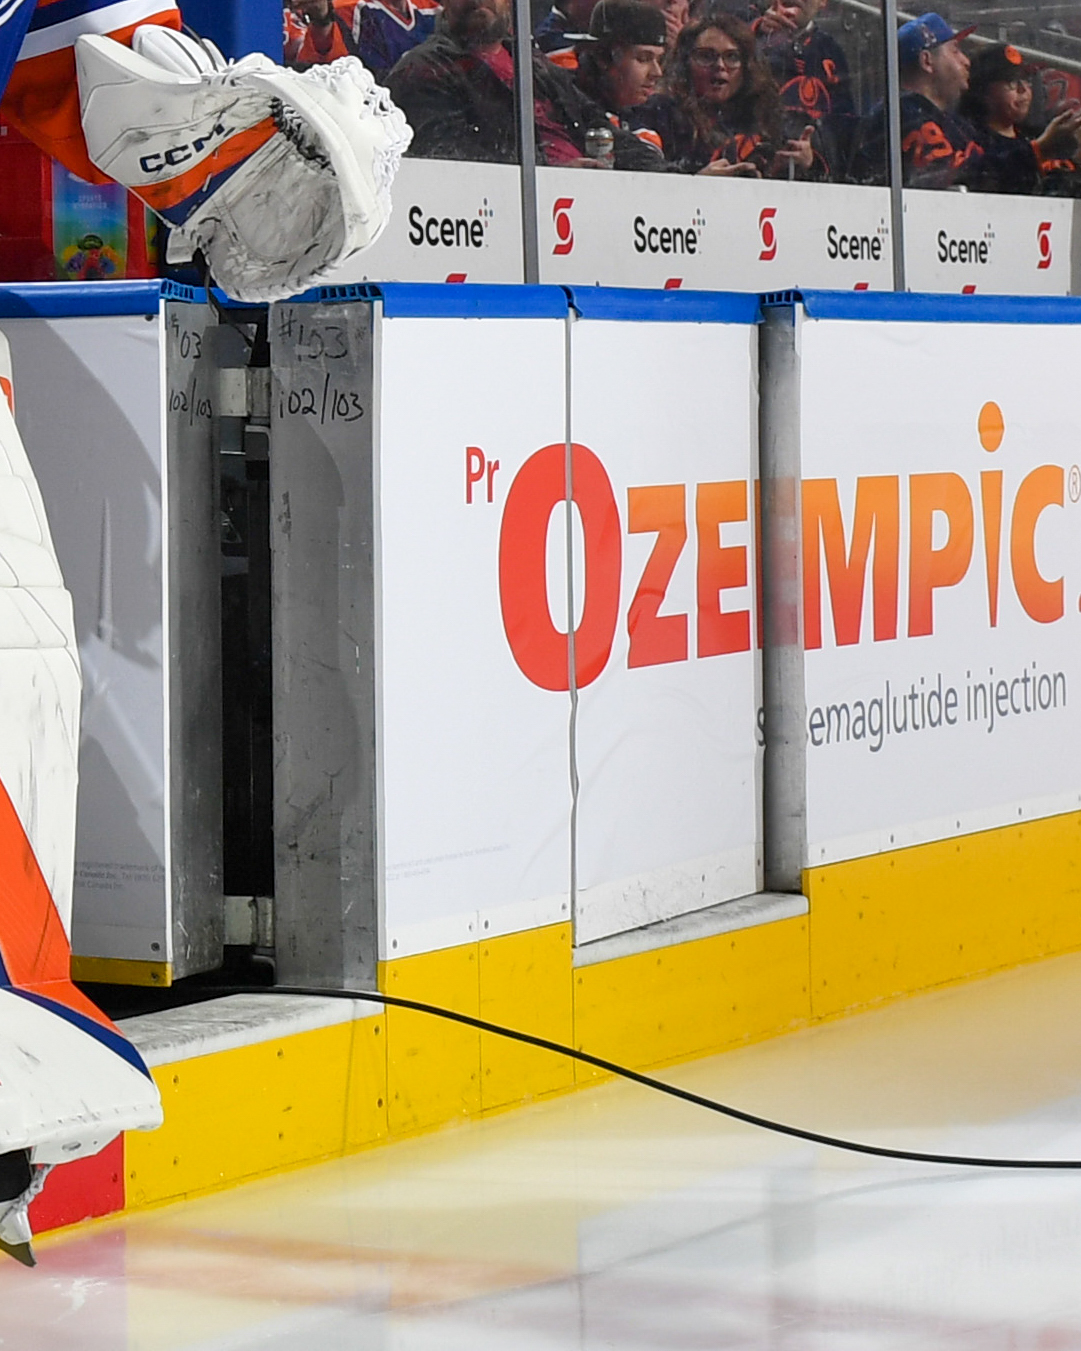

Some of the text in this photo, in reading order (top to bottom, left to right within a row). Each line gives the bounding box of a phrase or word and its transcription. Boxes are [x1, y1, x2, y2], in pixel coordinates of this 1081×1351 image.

[139, 109, 226, 174] CCM
[408, 205, 484, 248] Scene
[633, 215, 698, 255] Scene
[826, 224, 882, 261] Scene
[937, 230, 989, 264] Scene
[279, 373, 364, 425] 102/103
[465, 446, 500, 504] Pr
[966, 661, 1067, 734] injection
